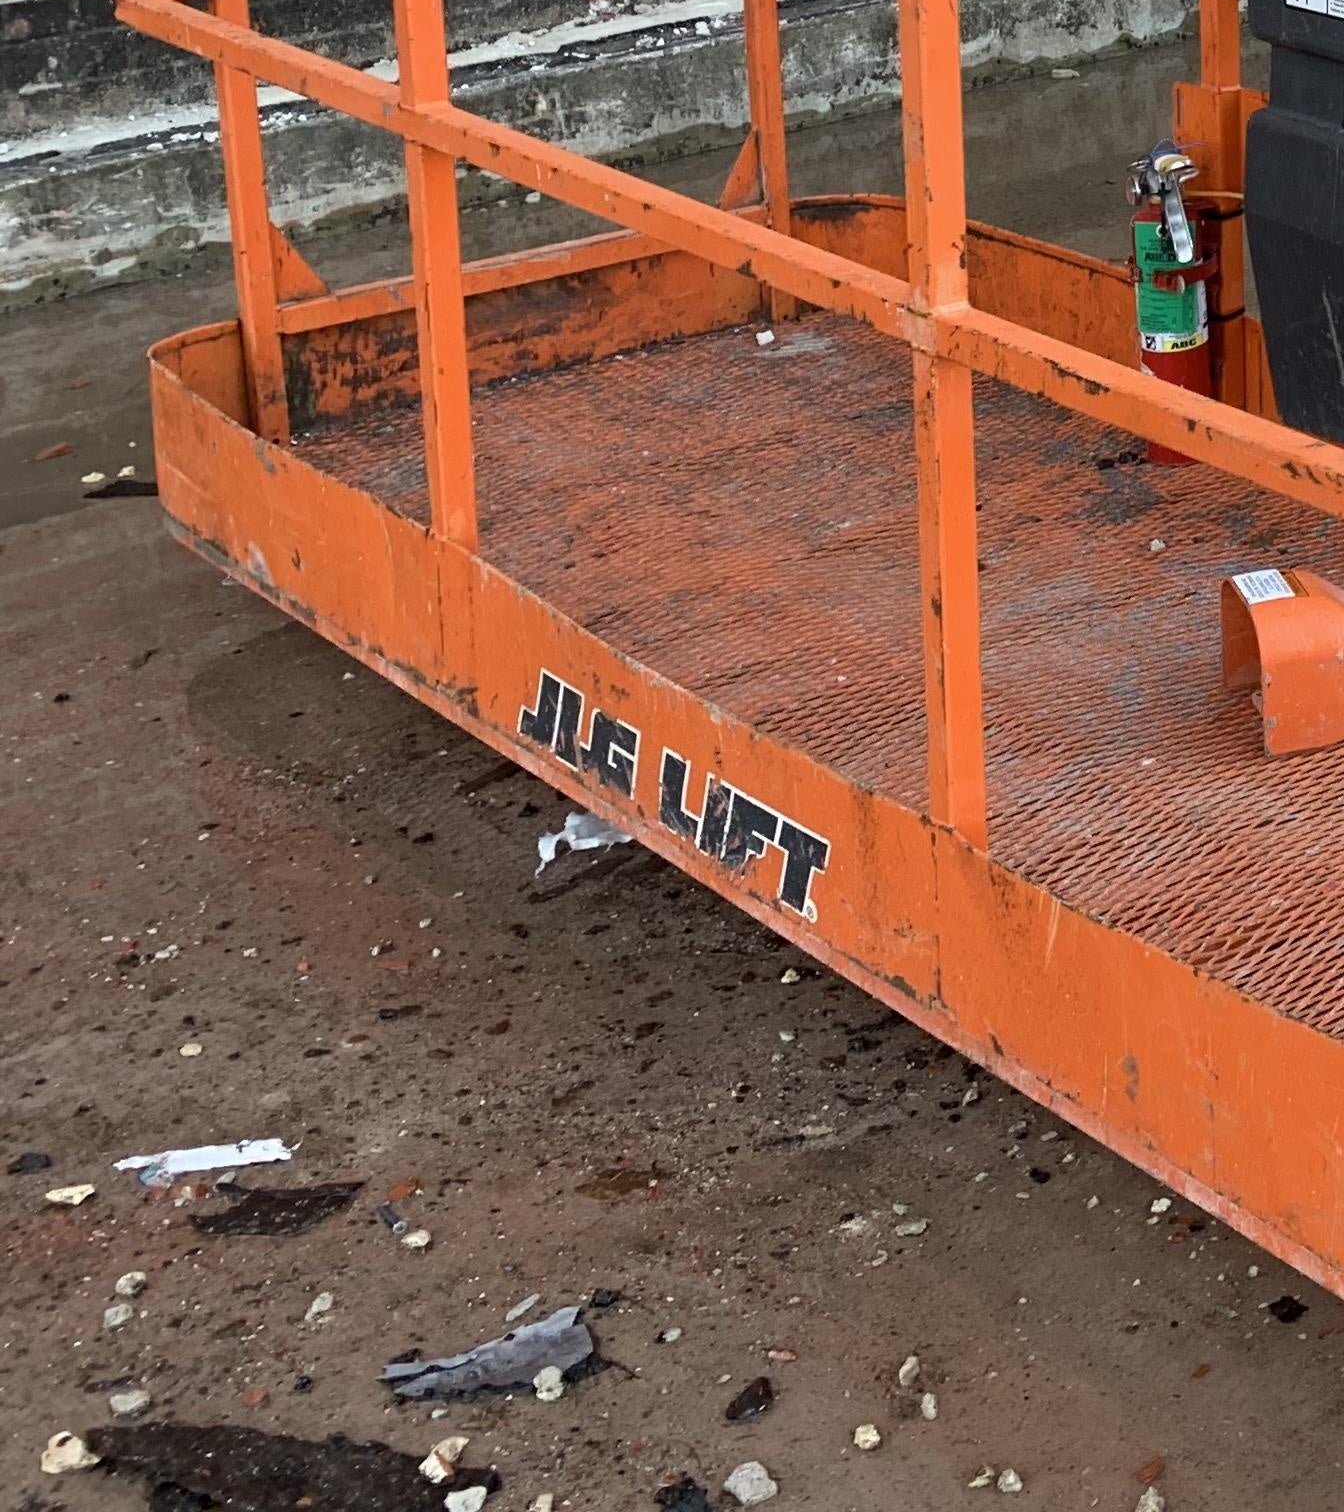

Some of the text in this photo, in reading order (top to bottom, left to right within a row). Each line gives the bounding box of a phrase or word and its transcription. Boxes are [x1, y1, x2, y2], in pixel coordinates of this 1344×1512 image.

[1171, 338, 1197, 350] ABC
[517, 667, 831, 918] JLG LIFT
